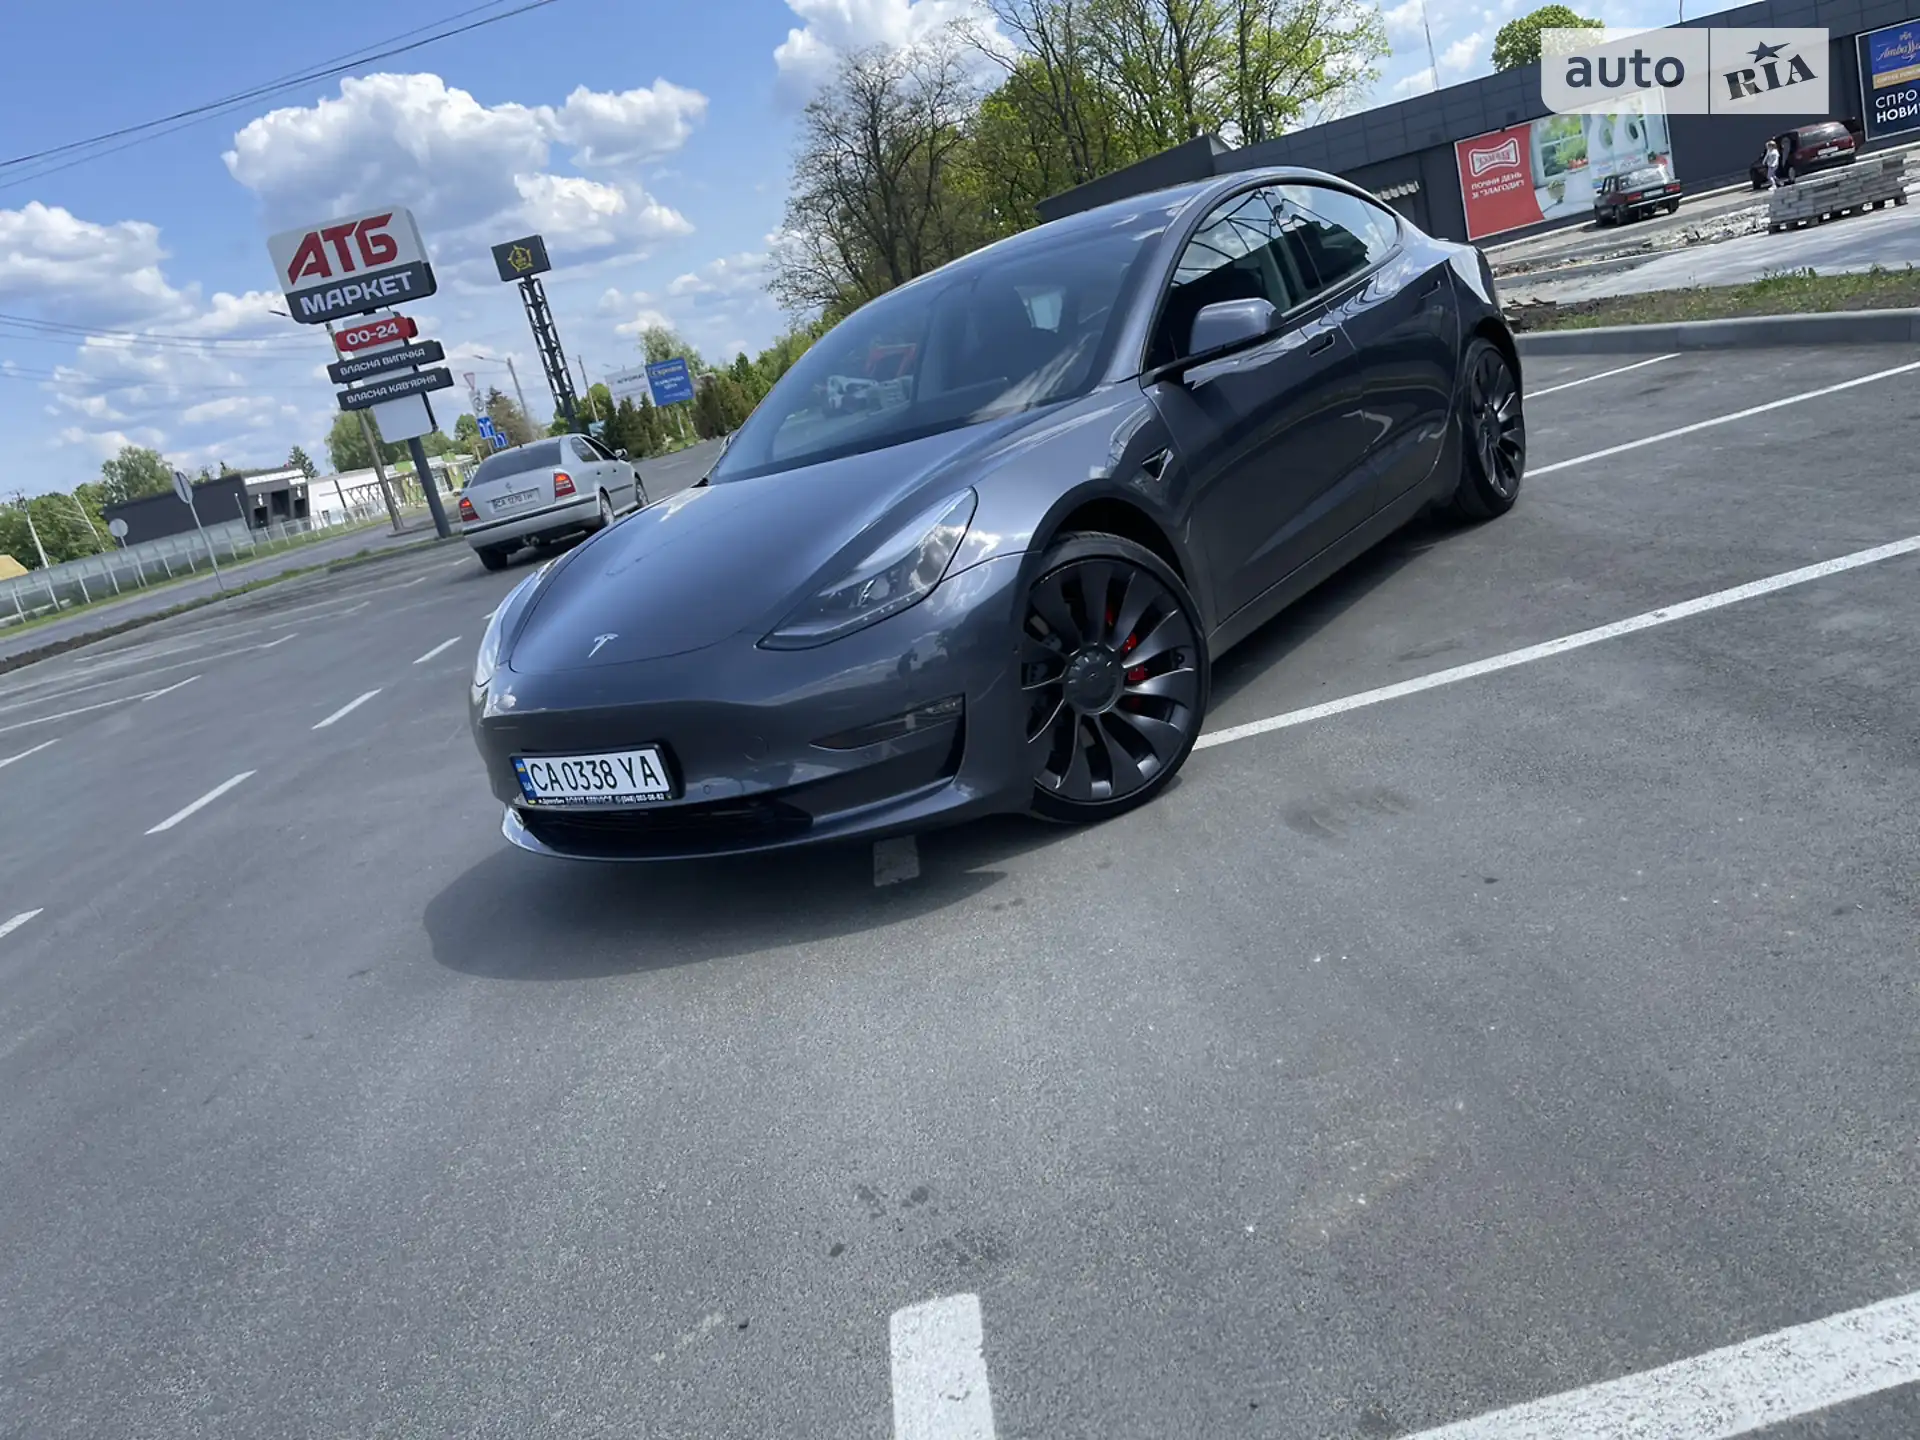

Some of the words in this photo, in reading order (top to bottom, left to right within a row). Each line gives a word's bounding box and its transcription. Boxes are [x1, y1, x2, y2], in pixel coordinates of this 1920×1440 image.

[1875, 89, 1917, 108] СПРО
[1876, 103, 1920, 123] НОВИ
[287, 212, 398, 286] АТБ
[300, 271, 413, 316] МАРКЕТ
[346, 322, 399, 345] 00-24
[340, 359, 381, 376] ВЛАСНА
[382, 348, 426, 365] ВИПІЧКА
[346, 387, 388, 404] ВЛАСНА
[530, 762, 564, 791] CA
[561, 760, 617, 791] 0338
[618, 755, 661, 788] YA
